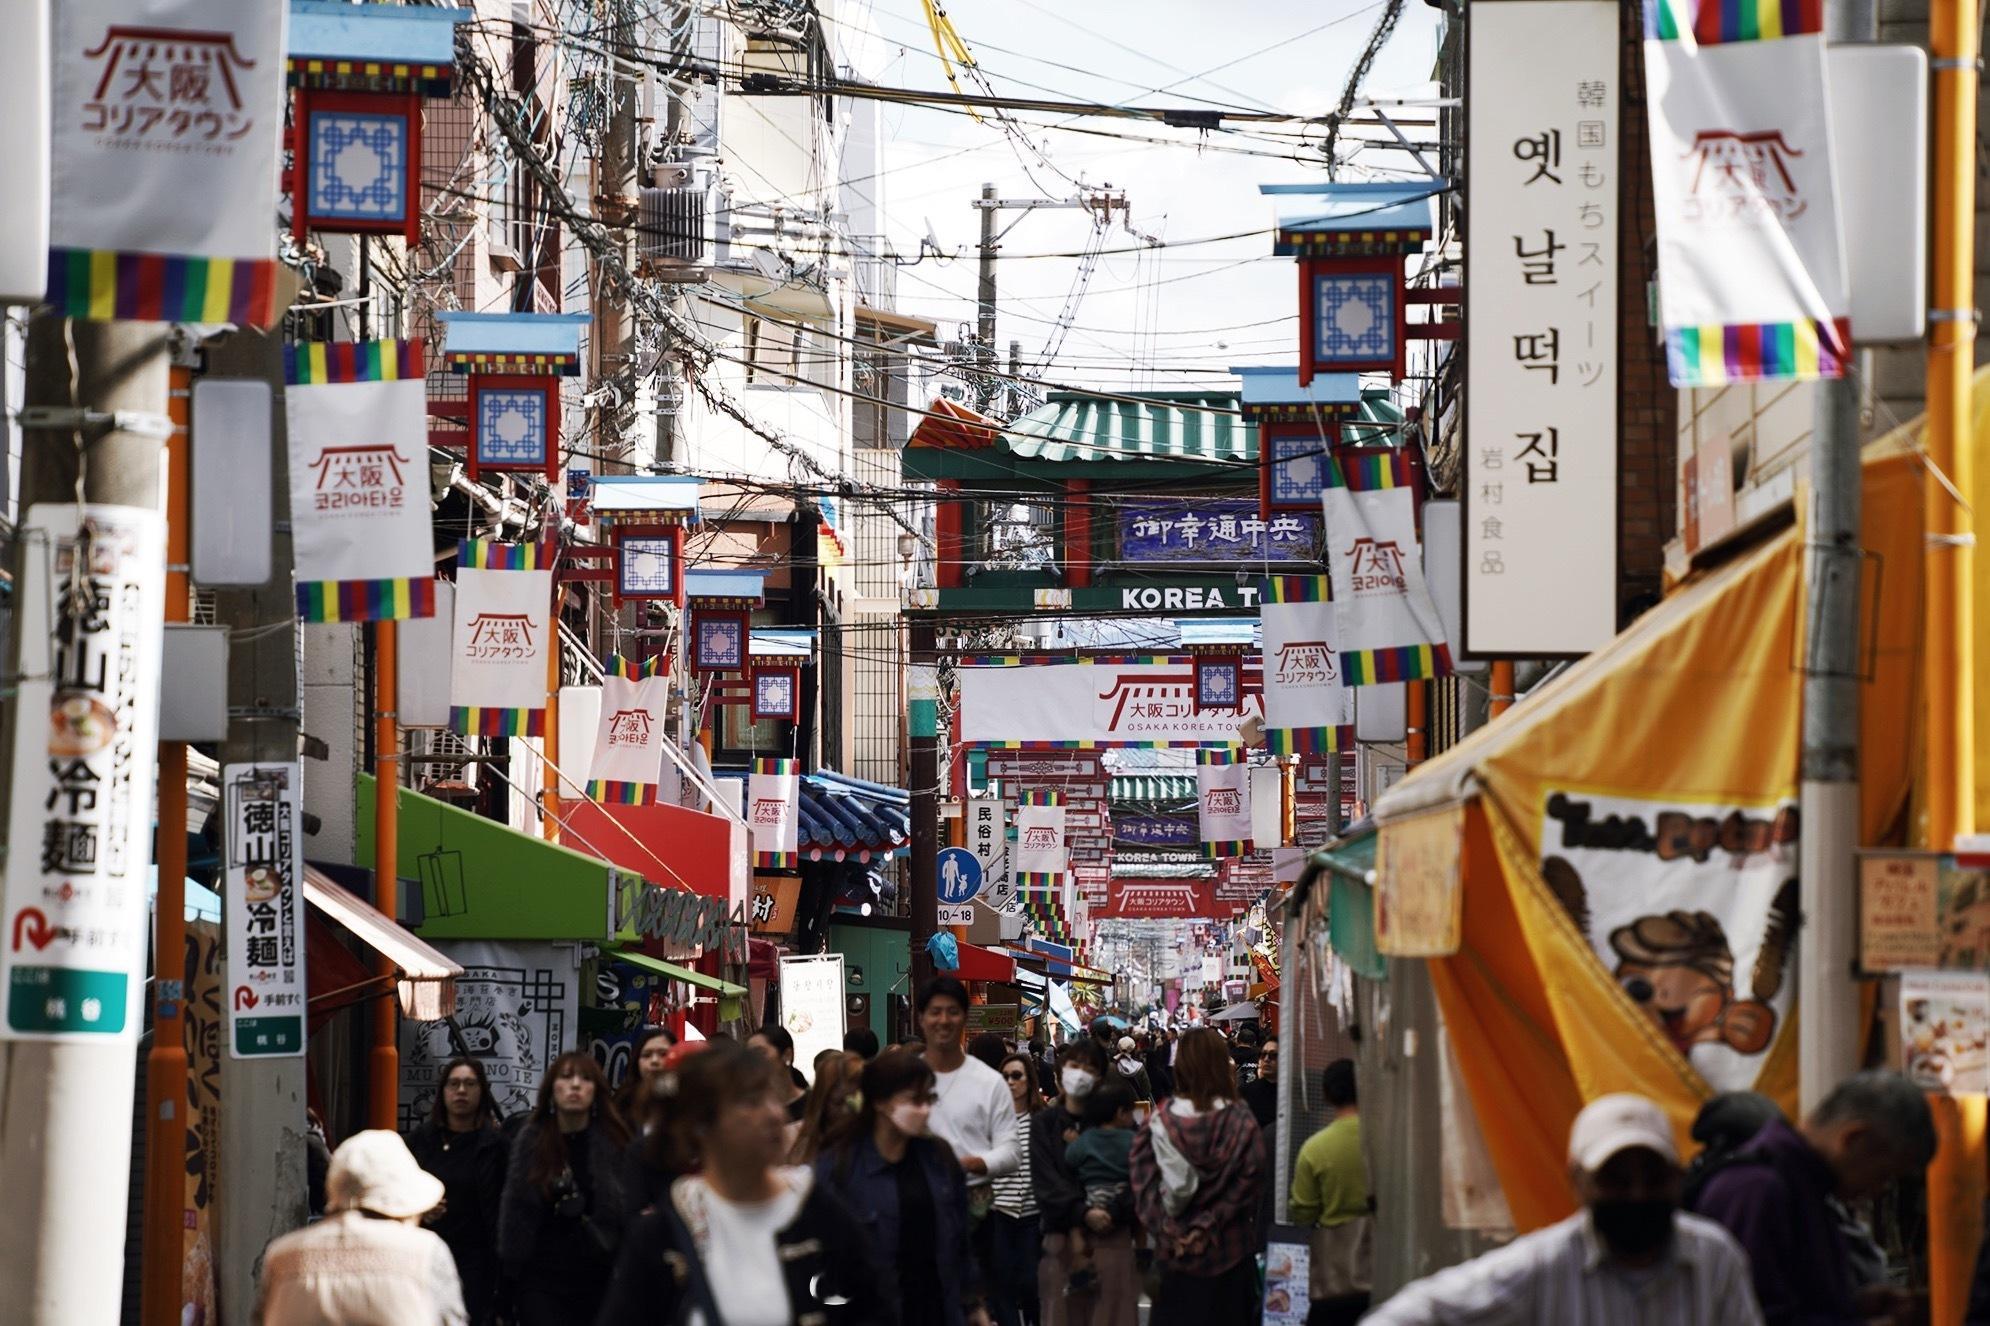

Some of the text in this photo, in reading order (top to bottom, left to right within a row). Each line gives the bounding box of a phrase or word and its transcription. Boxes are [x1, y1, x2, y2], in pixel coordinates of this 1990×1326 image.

[122, 61, 211, 105] 大阪
[81, 102, 253, 141] コリアタウン
[1576, 79, 1607, 388] 韓国もちスイーツ
[1512, 126, 1567, 486] 옛날떡집
[333, 465, 384, 488] 大阪
[315, 486, 404, 511] 코리아타운
[1480, 446, 1505, 577] 岩村食品
[1131, 511, 1305, 549] 御幸通中央
[1122, 587, 1262, 610] KOREA T
[484, 627, 519, 644] 大阪
[466, 645, 536, 658] コリアタウン
[1290, 653, 1321, 670] 大阪
[1275, 671, 1338, 684] コリアタウン
[1127, 722, 1169, 731] OSAKA
[1173, 722, 1214, 731] KOREA
[1207, 804, 1241, 815] 코리아타운
[1213, 796, 1233, 806] 大阪
[1023, 841, 1058, 850] コリアタウン
[1033, 834, 1049, 842] 大阪
[1117, 852, 1197, 863] KOREA TOWN
[1129, 897, 1185, 907] 大阪コリアタウン
[463, 971, 498, 979] SAKA
